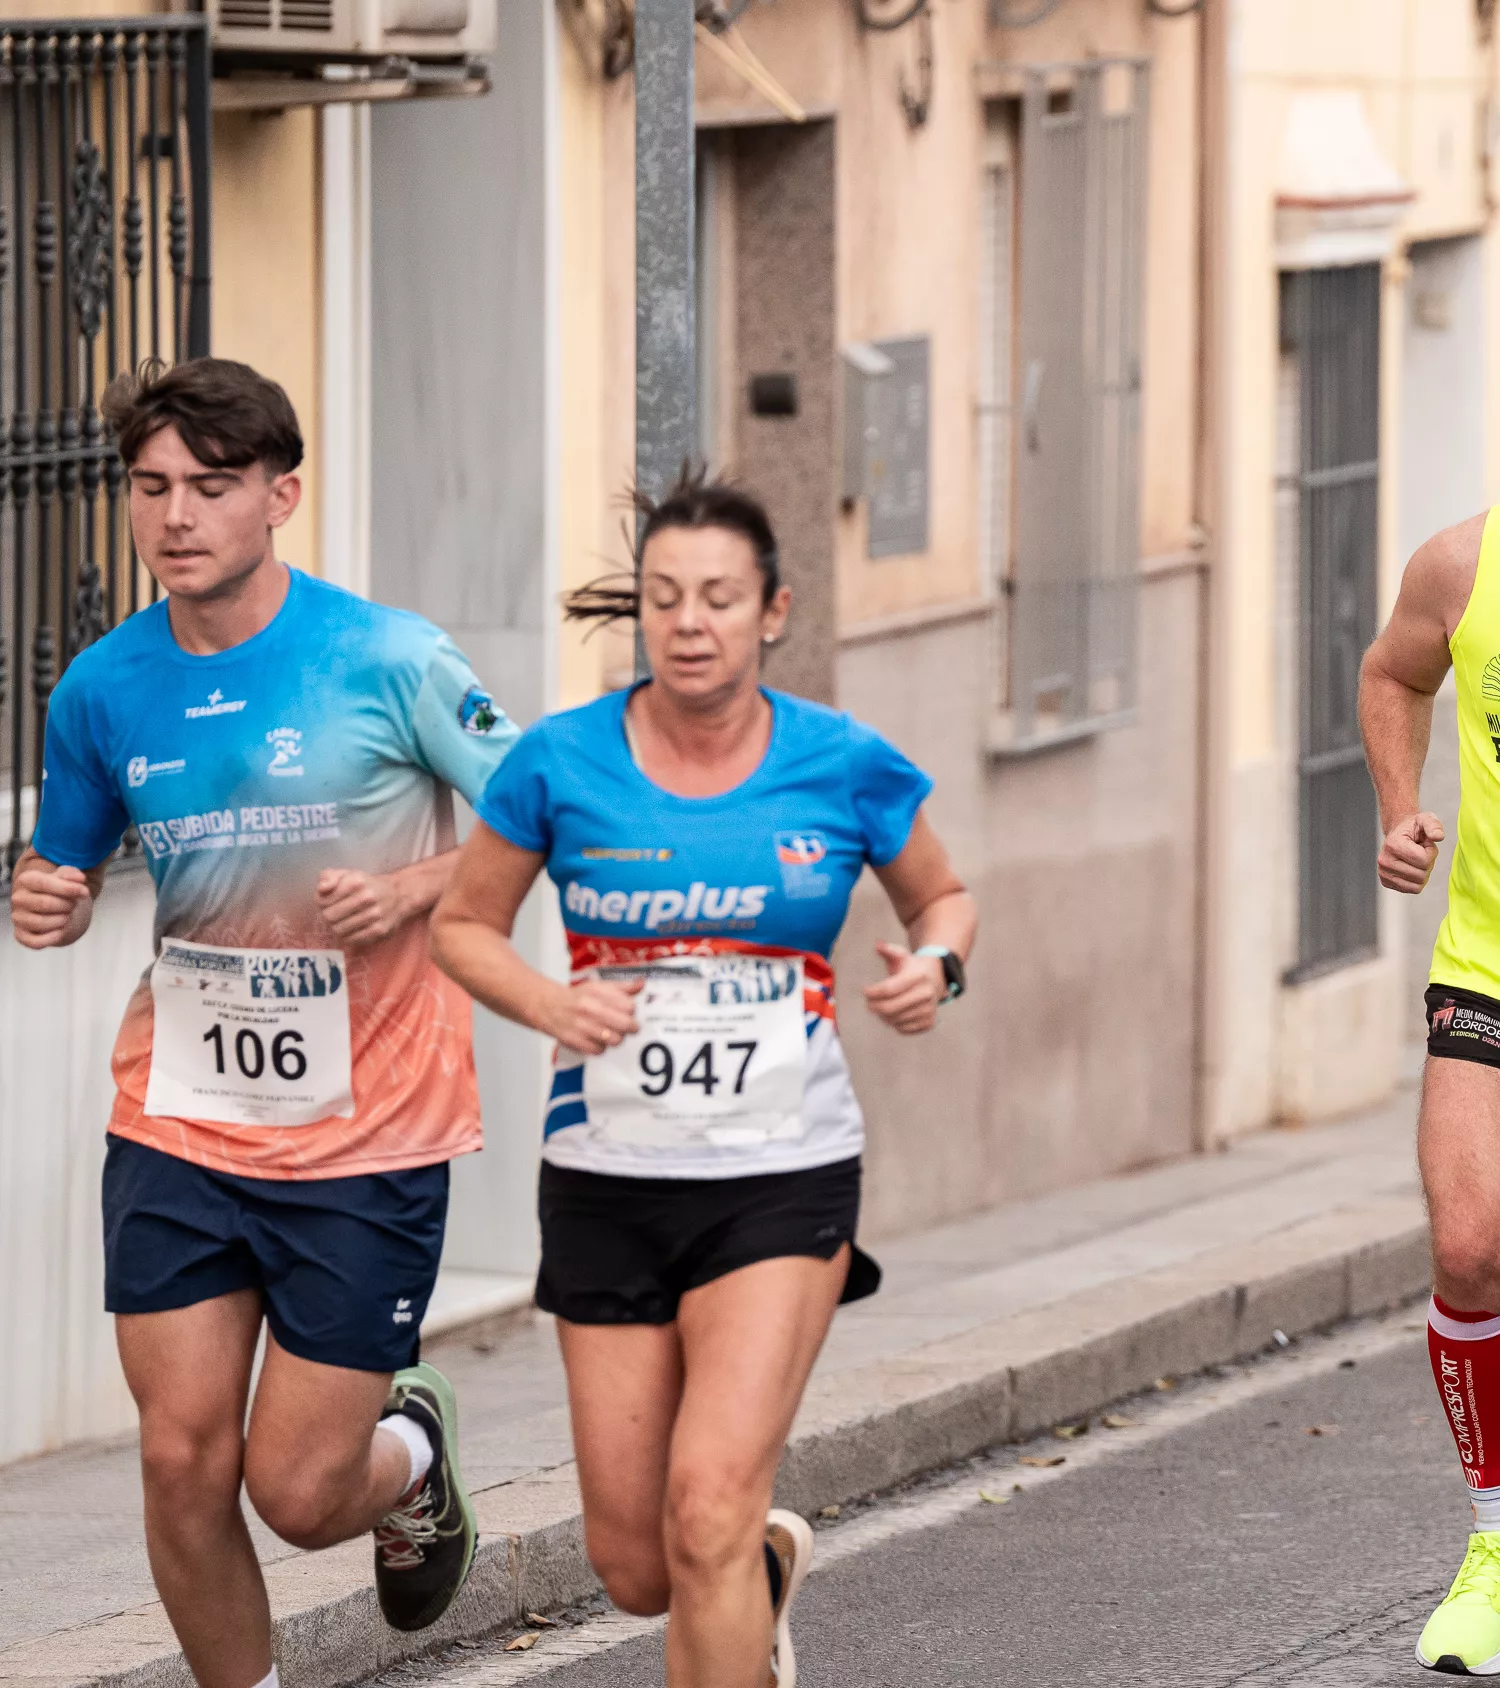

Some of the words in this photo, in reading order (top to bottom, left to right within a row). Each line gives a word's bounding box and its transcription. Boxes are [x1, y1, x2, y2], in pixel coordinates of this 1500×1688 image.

[166, 809, 236, 841] SUBIDA
[240, 801, 339, 831] PEDESTRE
[248, 956, 302, 977] 2024
[1456, 1008, 1474, 1020] MEDIA
[203, 1023, 308, 1081] 106
[1456, 1031, 1480, 1040] EDICIÓN
[639, 1041, 758, 1096] 947
[1464, 1359, 1474, 1390] TECHNOLOGY
[1467, 1388, 1480, 1424] COMPRESSION
